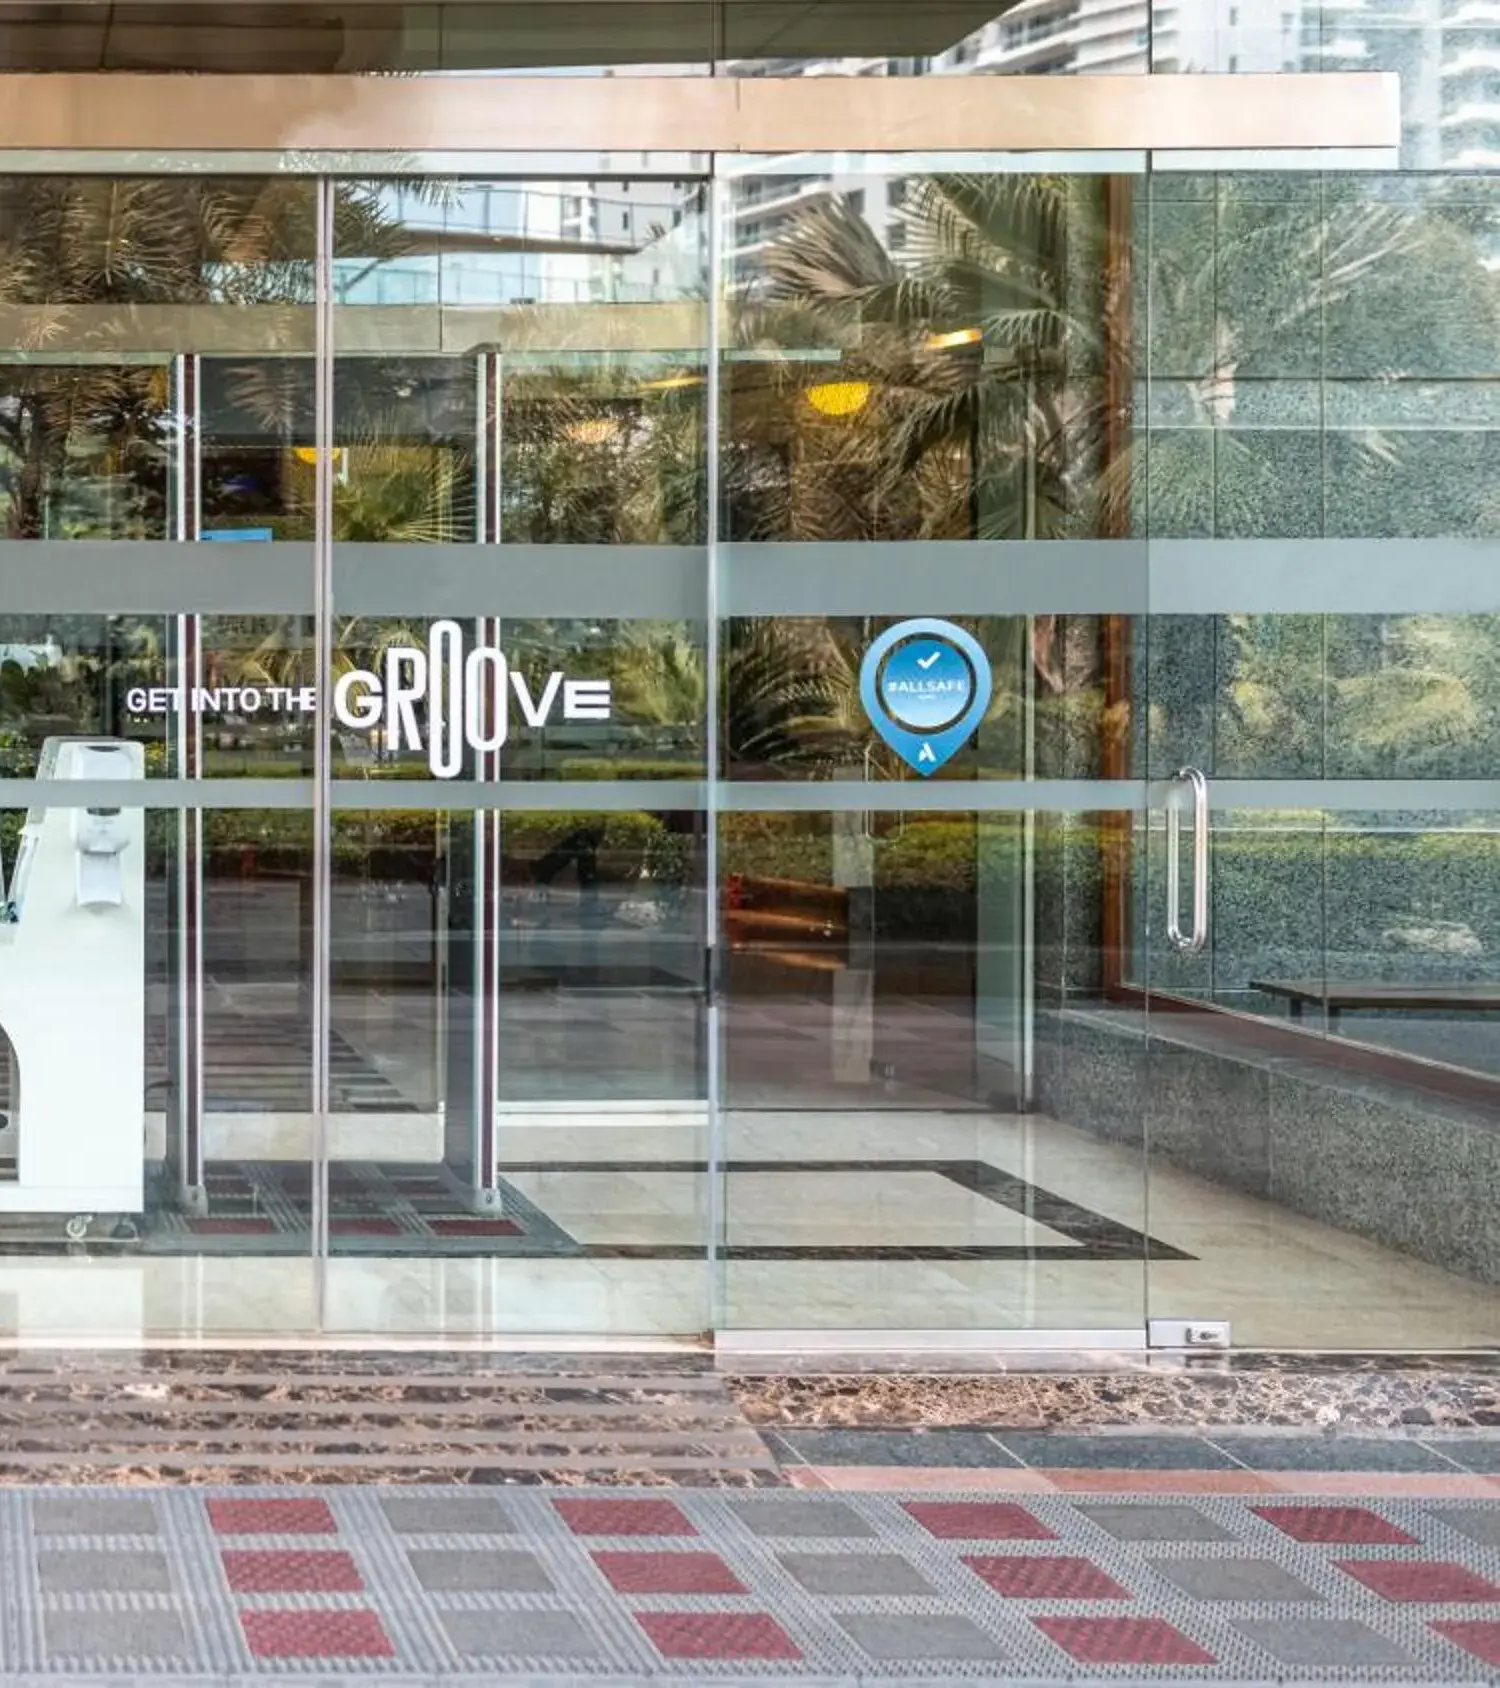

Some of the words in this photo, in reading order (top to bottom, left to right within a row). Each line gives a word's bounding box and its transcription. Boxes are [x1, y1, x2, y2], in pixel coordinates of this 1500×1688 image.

[127, 687, 184, 712] GET
[191, 687, 261, 712] INTO
[266, 687, 317, 712] THE
[334, 620, 611, 778] GROOVE
[887, 680, 963, 693] #ALLSAFE
